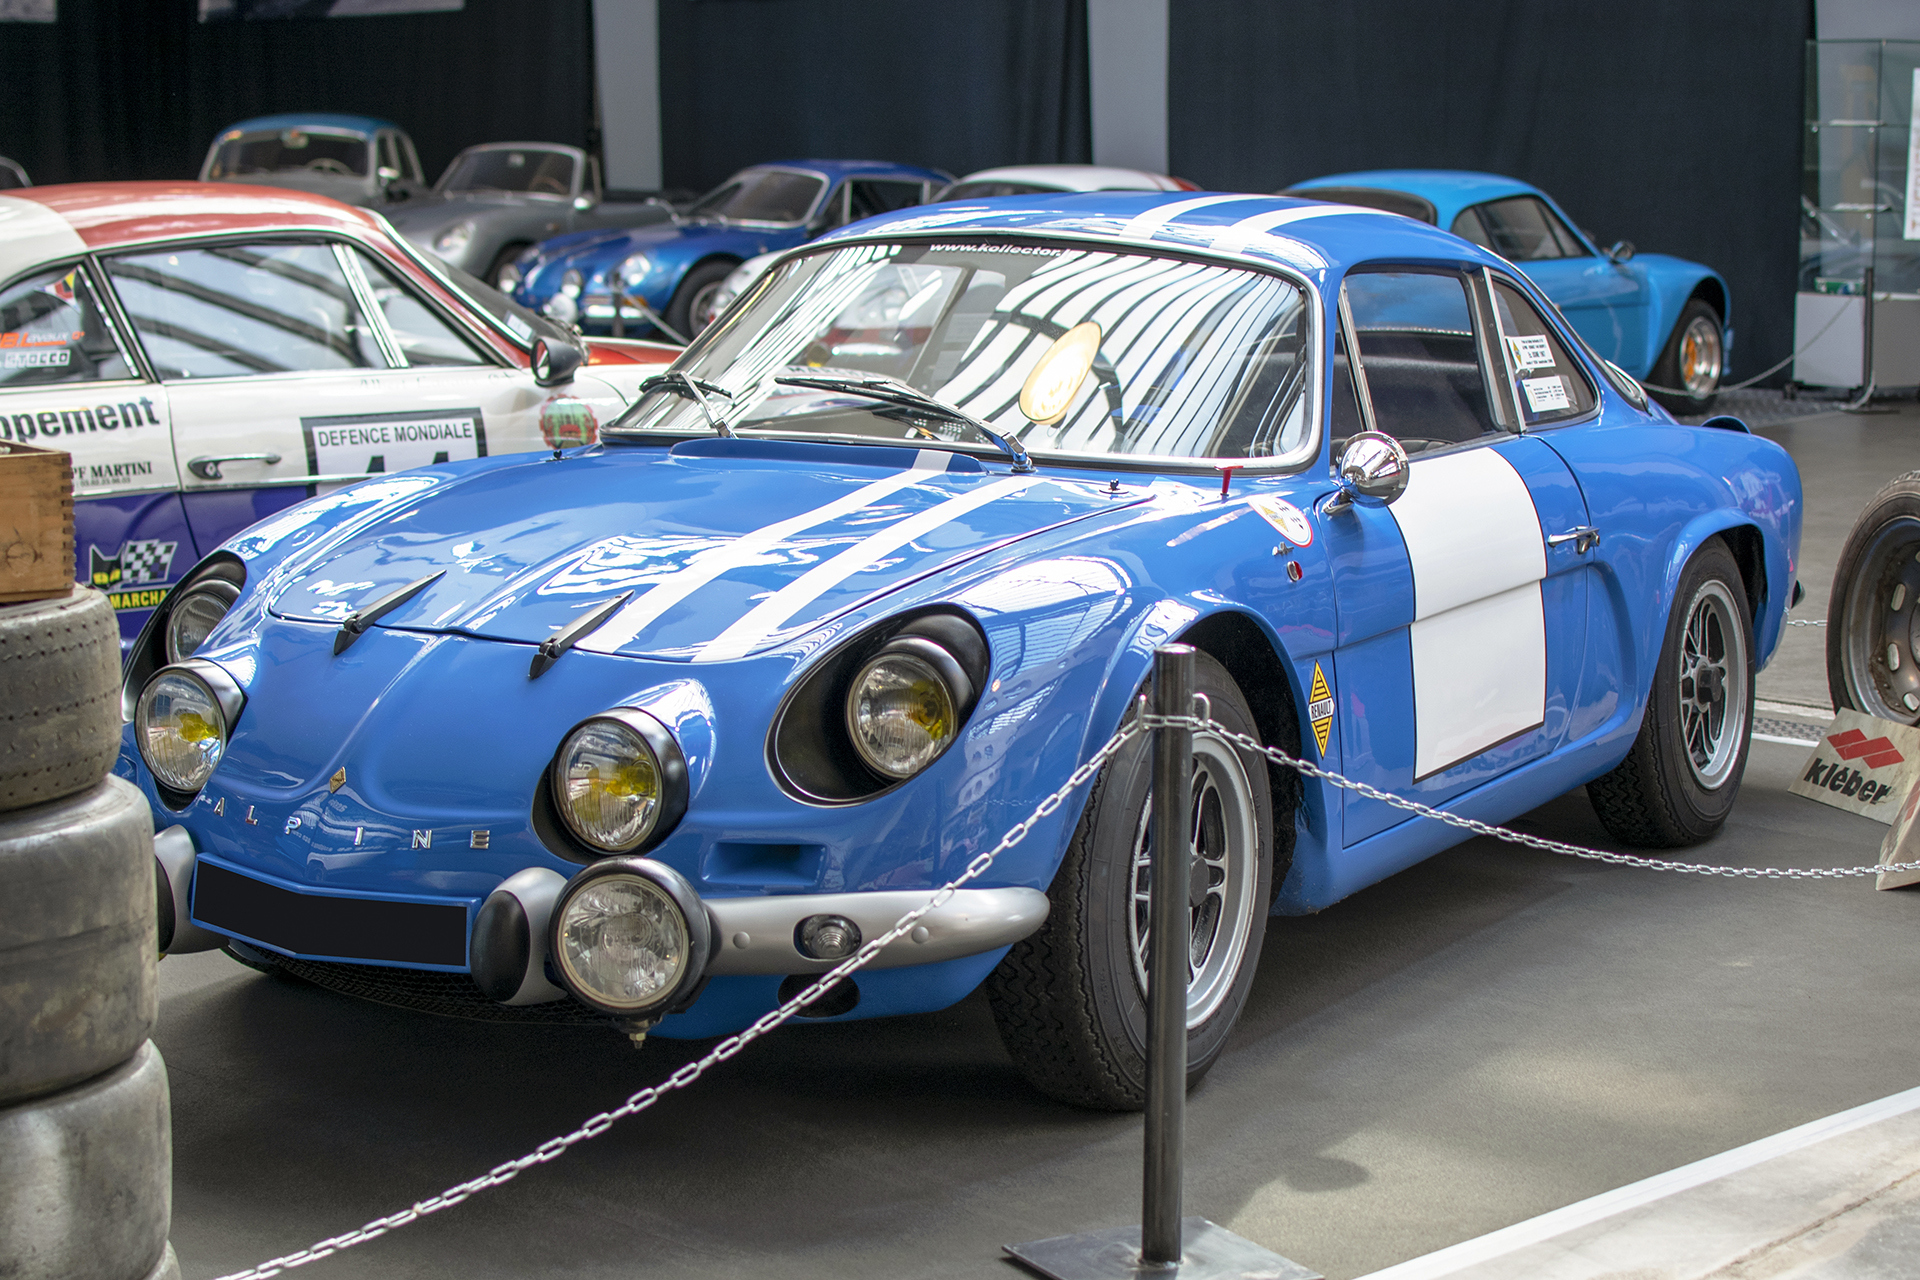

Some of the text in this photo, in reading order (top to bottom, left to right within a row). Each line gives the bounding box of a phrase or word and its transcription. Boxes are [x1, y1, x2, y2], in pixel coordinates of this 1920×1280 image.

[318, 422, 472, 447] DEFENCE MONDIALE
[90, 461, 153, 478] MARTINI
[109, 590, 168, 609] MARCHA
[1311, 700, 1331, 720] RENAULT
[1803, 757, 1892, 805] kléber
[213, 797, 490, 849] ALPINE
